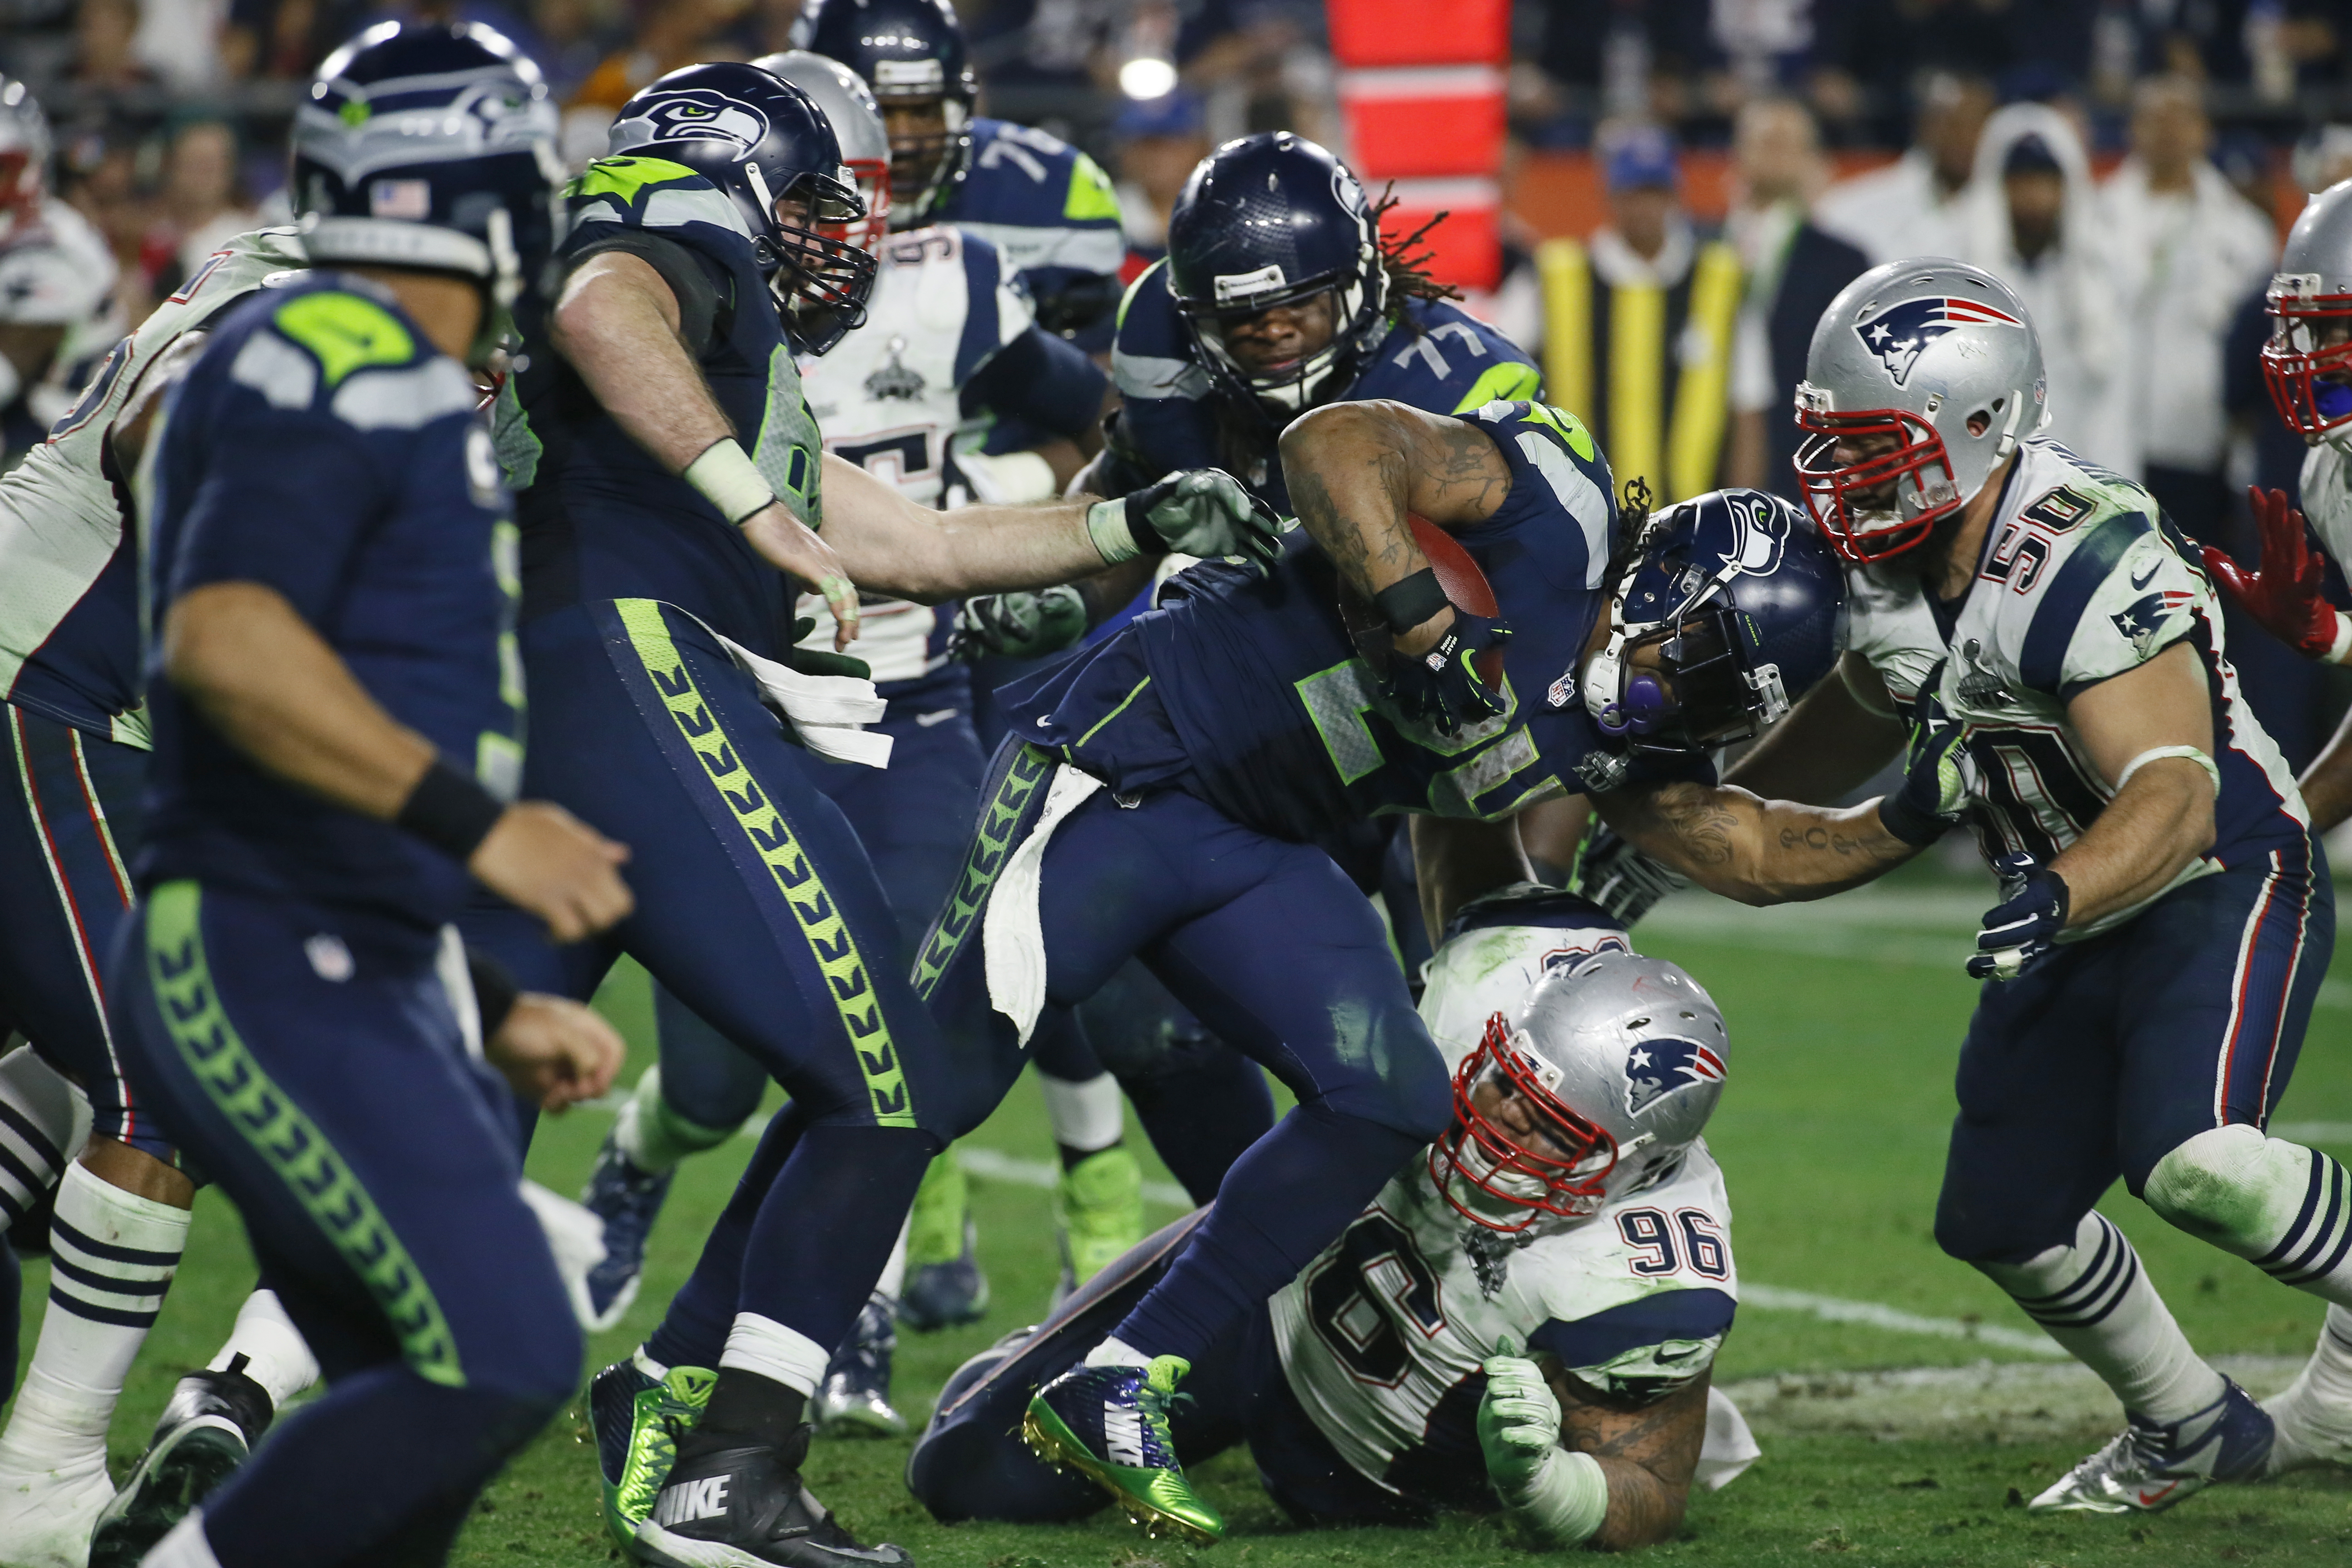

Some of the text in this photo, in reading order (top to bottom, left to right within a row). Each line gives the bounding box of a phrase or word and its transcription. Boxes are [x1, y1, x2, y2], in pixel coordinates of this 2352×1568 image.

[1392, 321, 1487, 381] 77
[1979, 483, 2100, 596] 50
[1440, 635, 1452, 651] MODE
[1744, 614, 1760, 647] SEAHAWKS
[1552, 682, 1565, 703] NFL
[1614, 1206, 1730, 1282] 96
[1104, 1399, 1144, 1468] NIKE
[655, 1474, 731, 1528] NIKE
